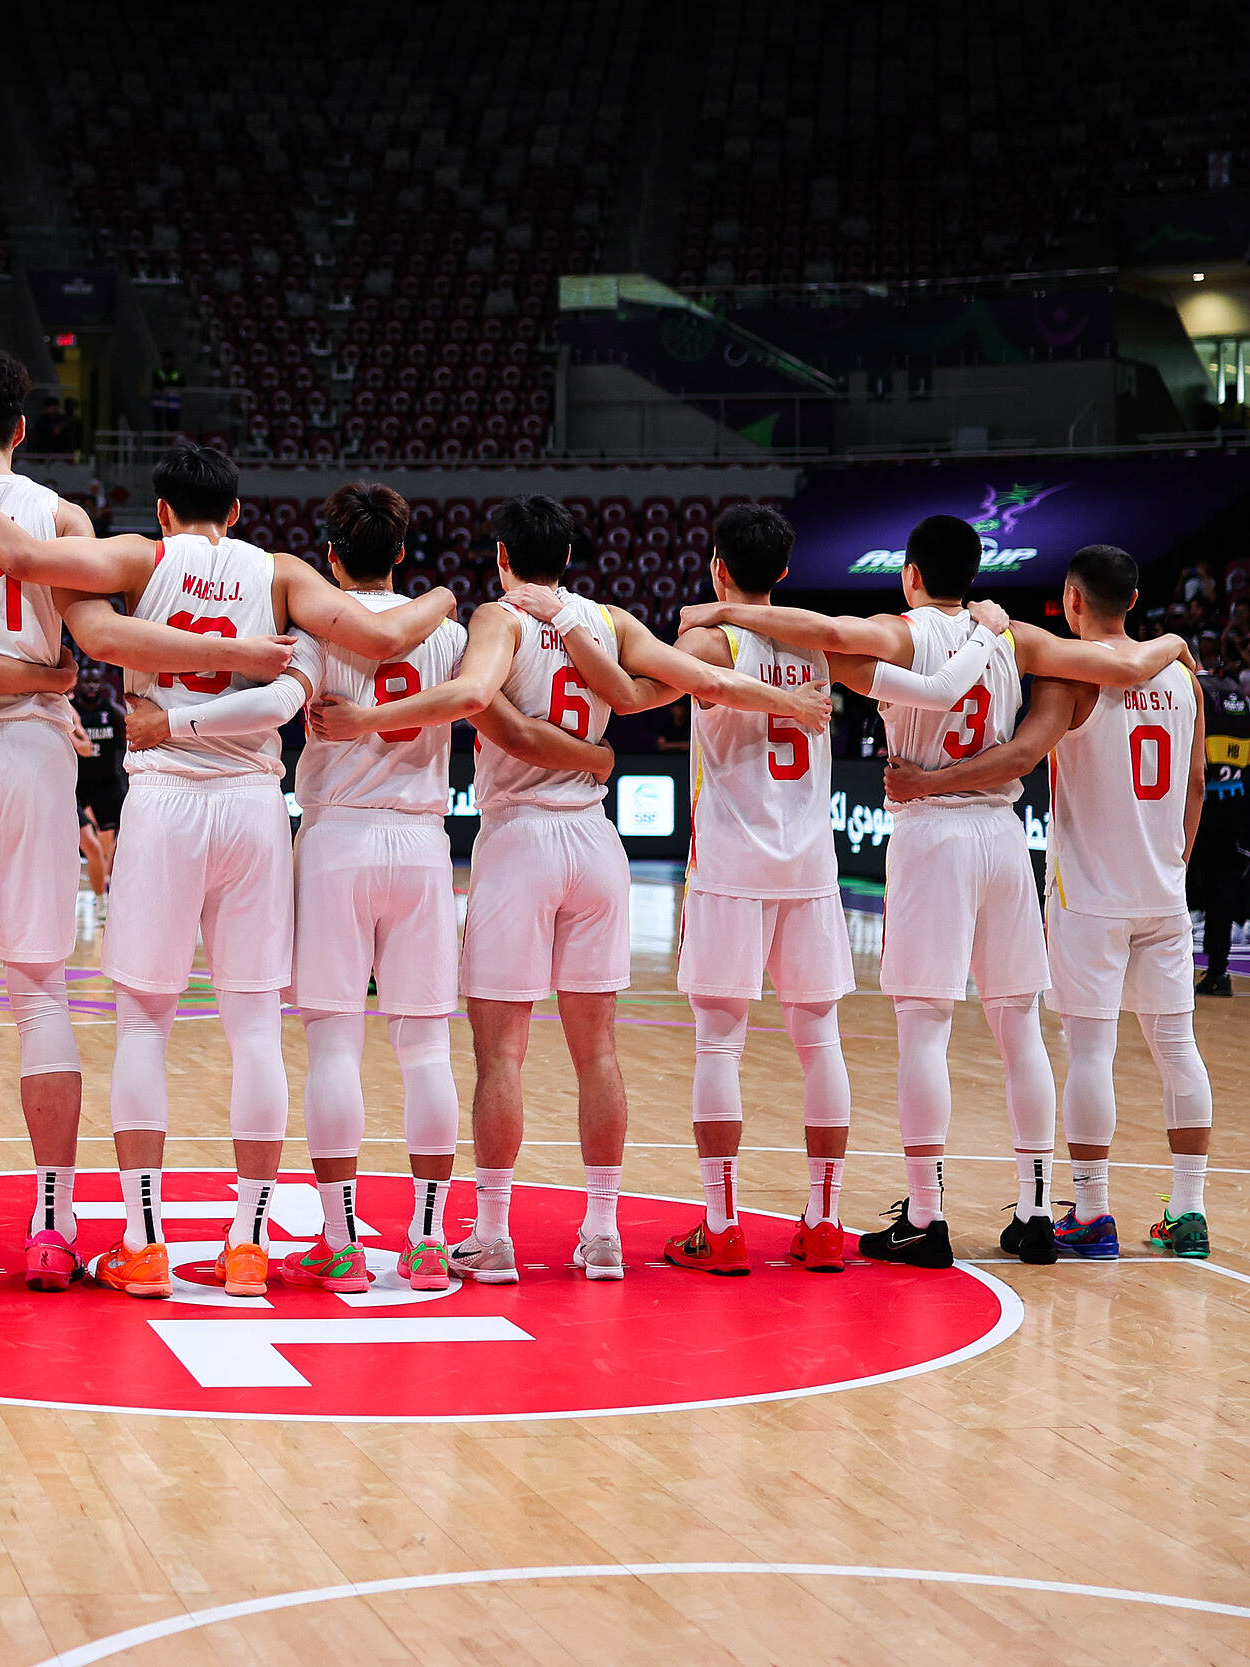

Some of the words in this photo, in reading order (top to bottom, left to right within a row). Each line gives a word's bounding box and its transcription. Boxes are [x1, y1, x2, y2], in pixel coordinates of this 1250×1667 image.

[213, 581, 243, 602] J.J.
[373, 660, 423, 744] 8
[548, 665, 591, 740] 6
[942, 684, 992, 761] 3
[1124, 689, 1148, 711] GAO
[1150, 690, 1179, 711] S.Y.
[767, 710, 810, 781] 5
[1128, 724, 1172, 801] 0
